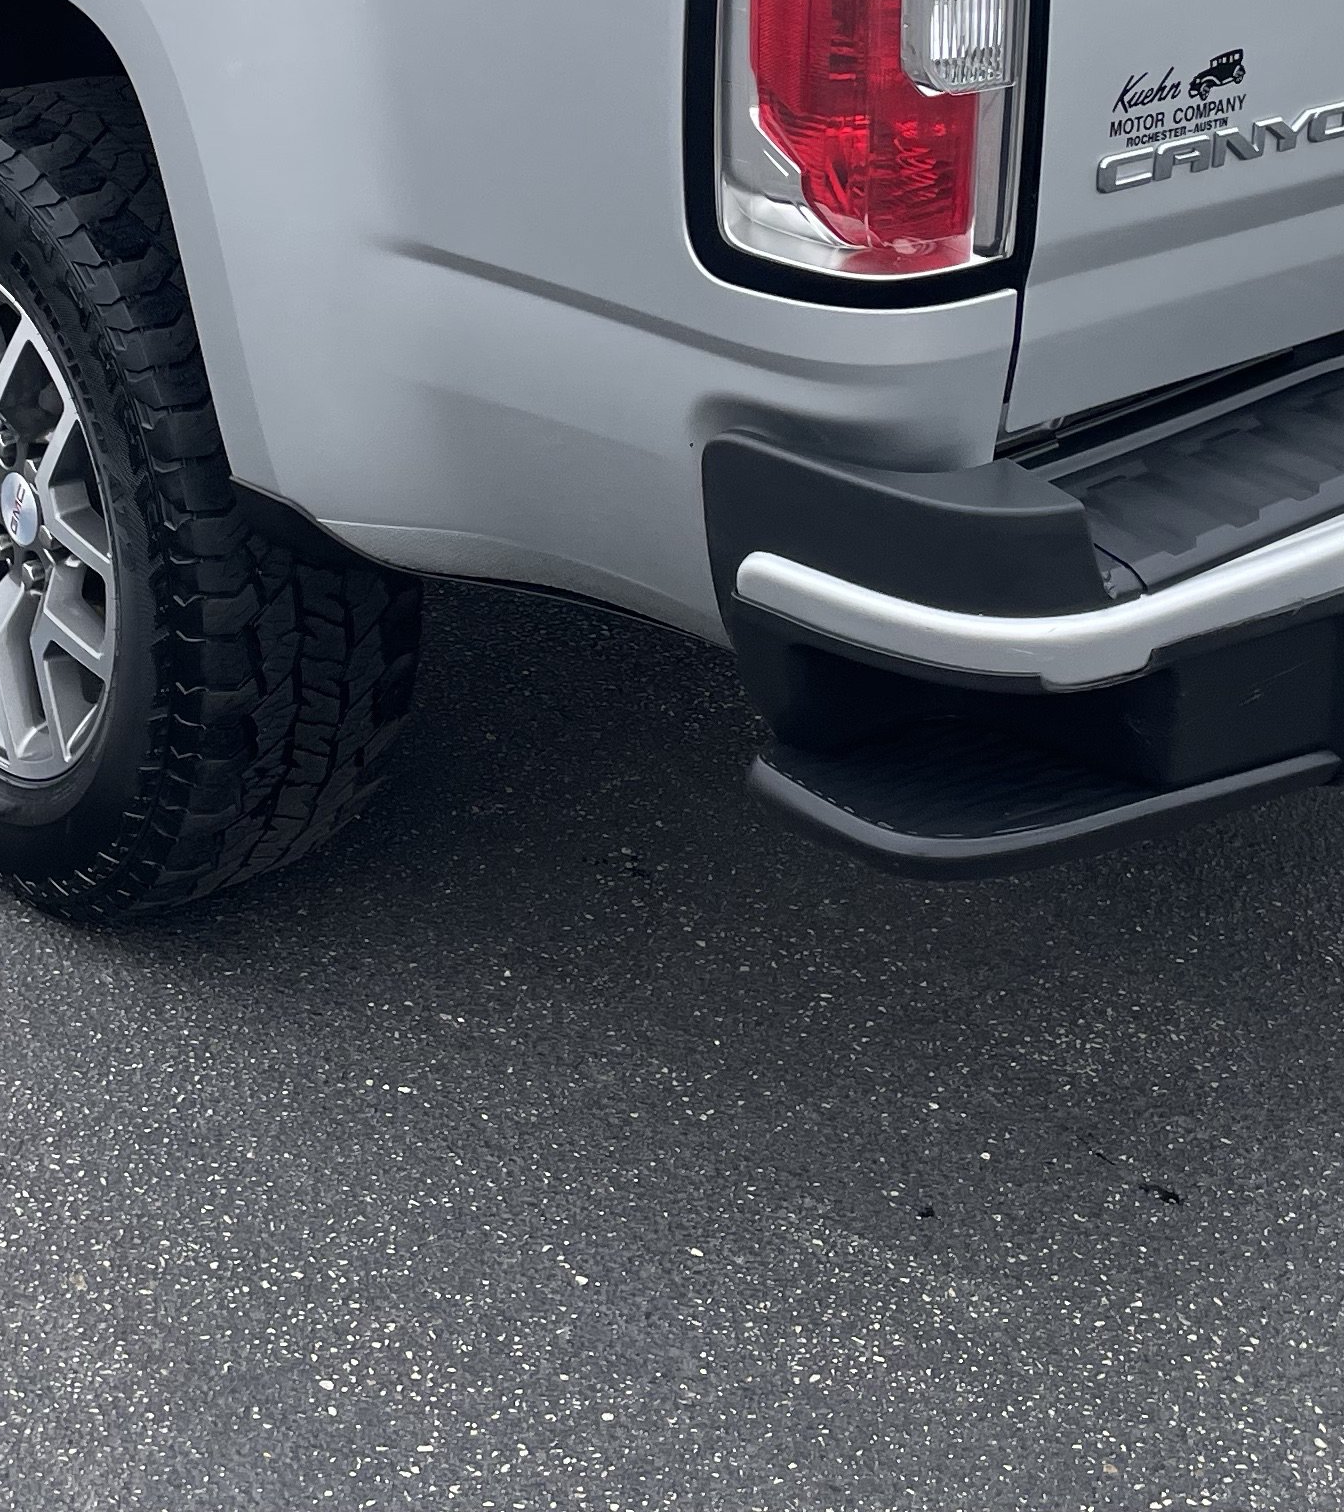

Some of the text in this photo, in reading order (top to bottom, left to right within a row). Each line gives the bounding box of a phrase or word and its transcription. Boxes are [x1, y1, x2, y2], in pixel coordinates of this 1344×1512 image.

[1112, 66, 1181, 114] Kuehn
[1109, 93, 1247, 137] MOTOR COMPANY
